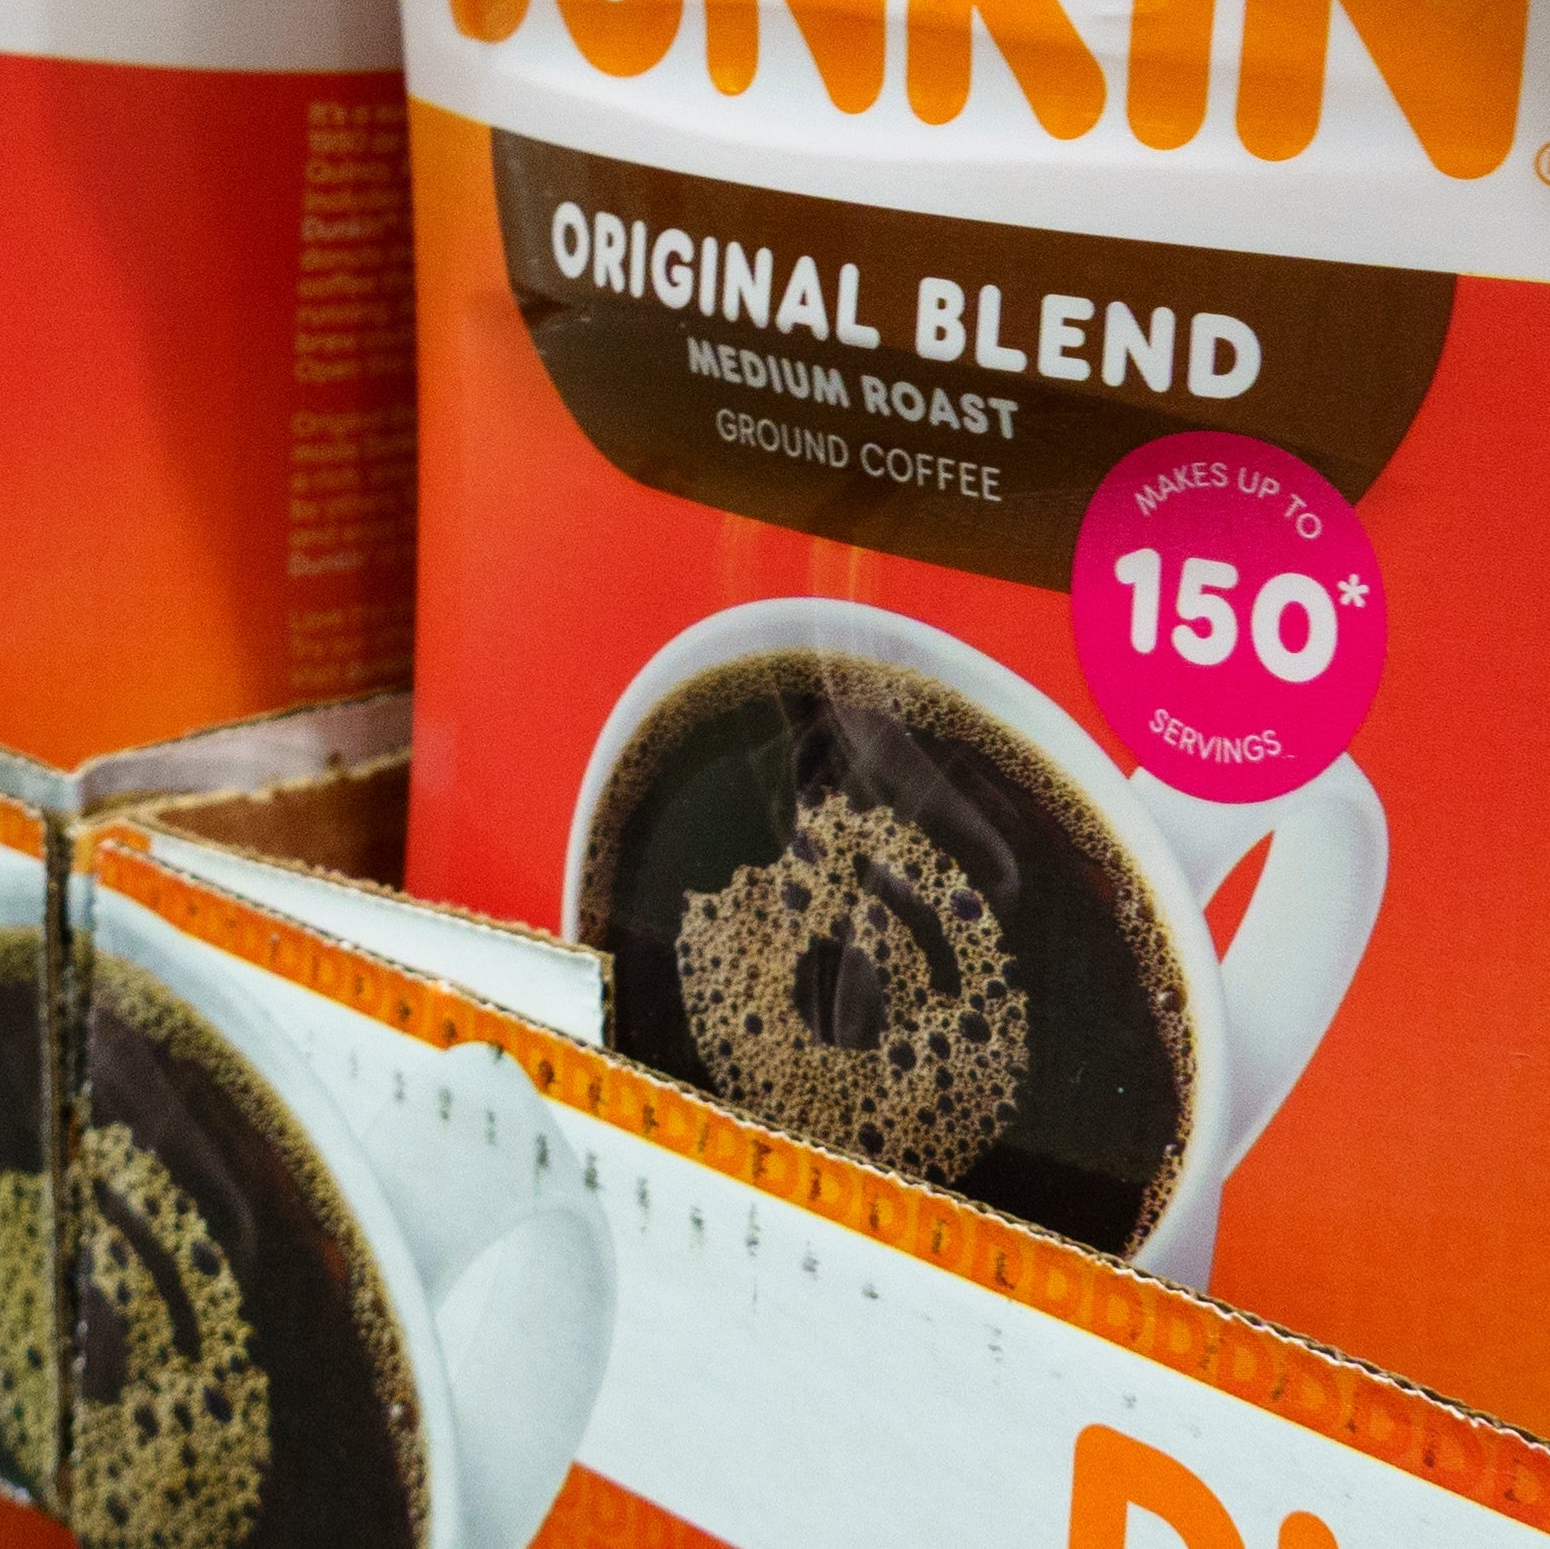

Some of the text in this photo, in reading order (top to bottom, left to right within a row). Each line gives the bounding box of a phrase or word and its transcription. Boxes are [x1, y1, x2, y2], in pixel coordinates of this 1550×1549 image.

[551, 201, 1263, 401] ORIGINAL BLEND
[687, 336, 1019, 441] MEDIUM ROAST
[715, 408, 1004, 504] GROUND COFFEE
[1134, 461, 1324, 540] MAKES UP TO
[1149, 708, 1283, 766] SERVINGS
